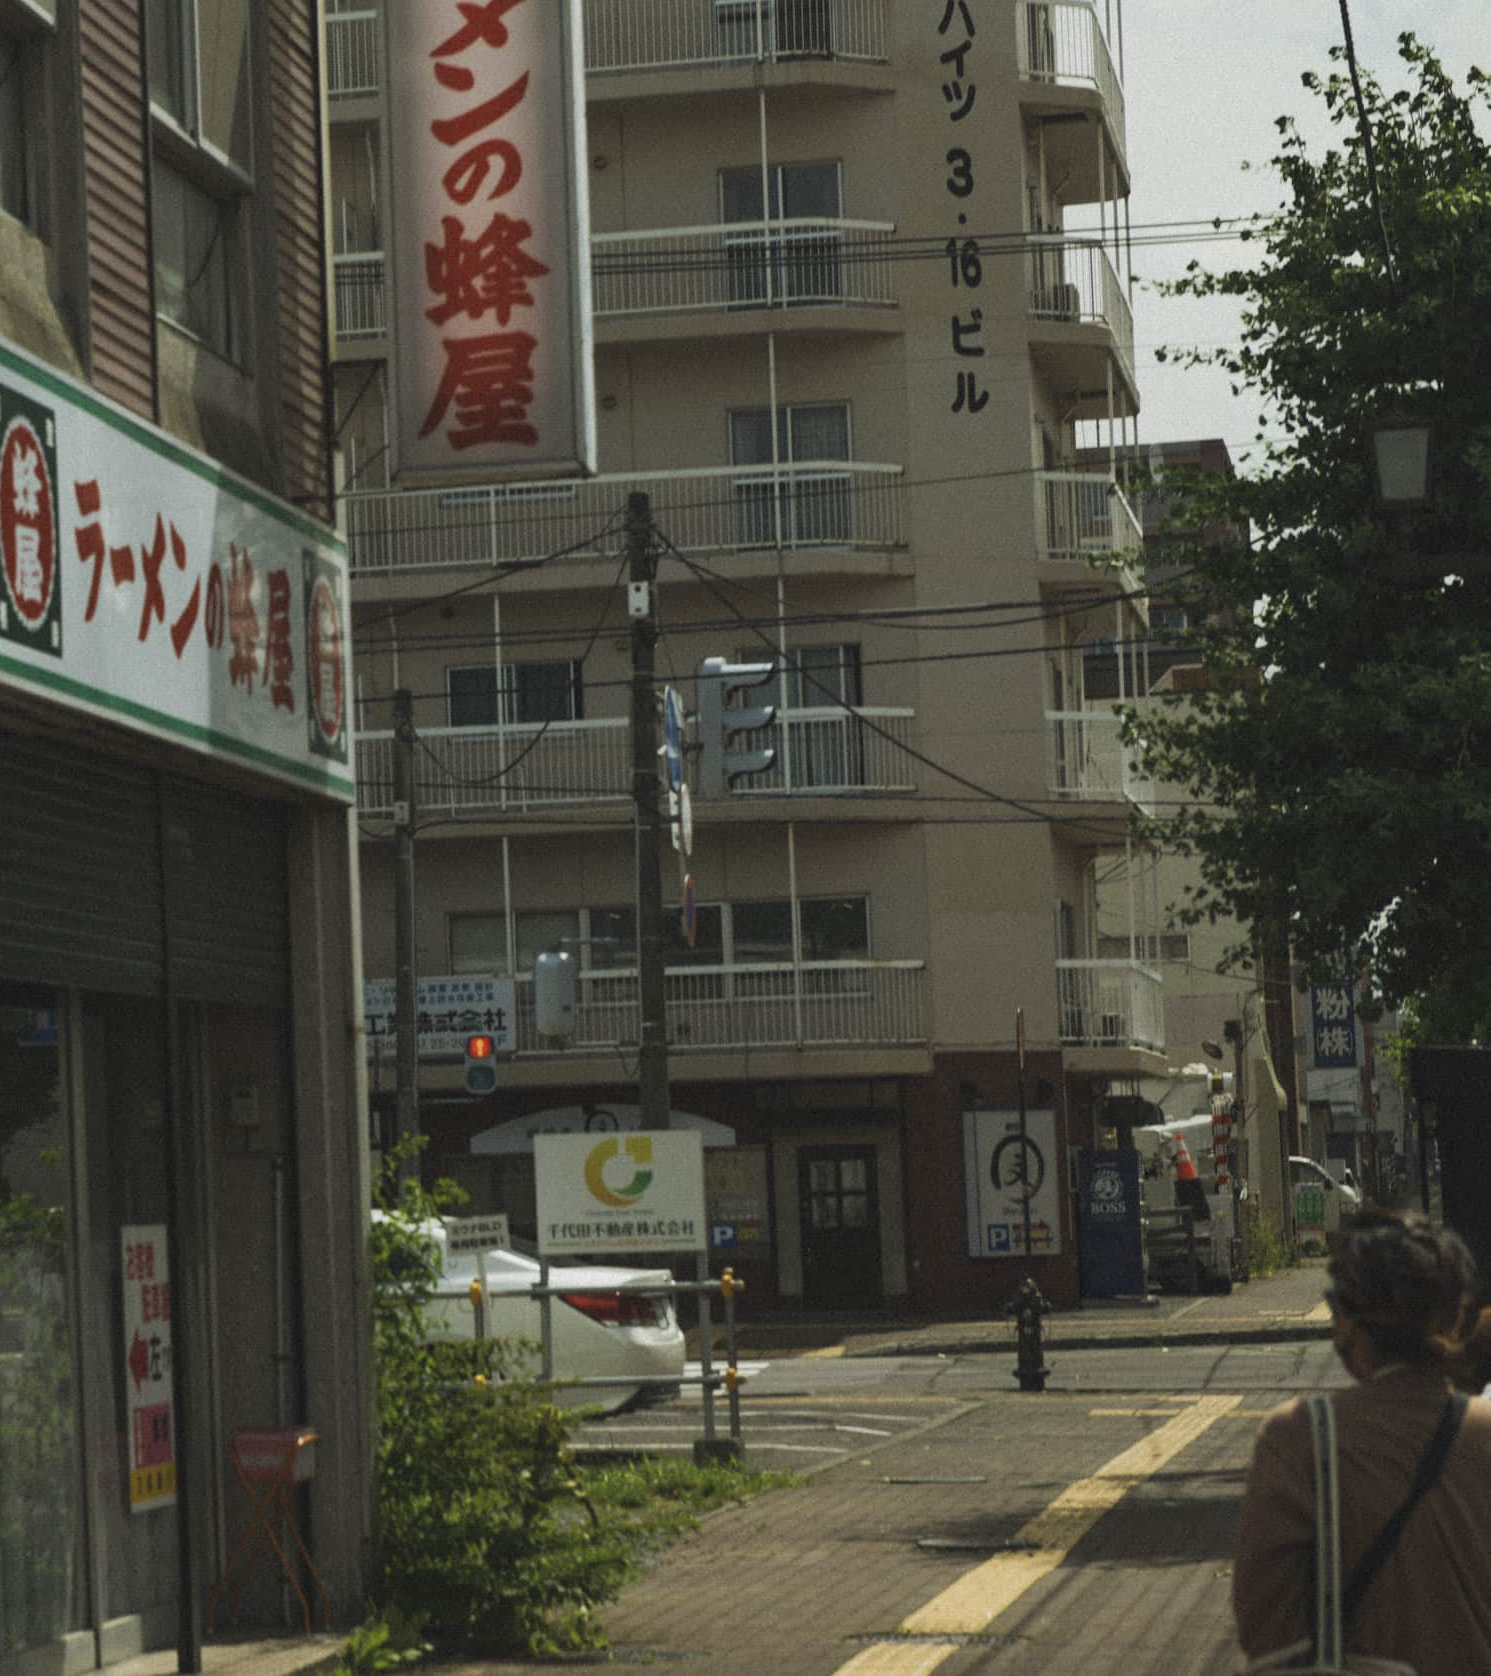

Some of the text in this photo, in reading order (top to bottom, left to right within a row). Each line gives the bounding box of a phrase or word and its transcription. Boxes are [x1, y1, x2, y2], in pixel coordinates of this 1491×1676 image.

[74, 479, 295, 714] ラーメンの蜂屋
[1090, 1200, 1127, 1215] BOSS
[548, 1220, 695, 1240] 千代田不動産株式会社
